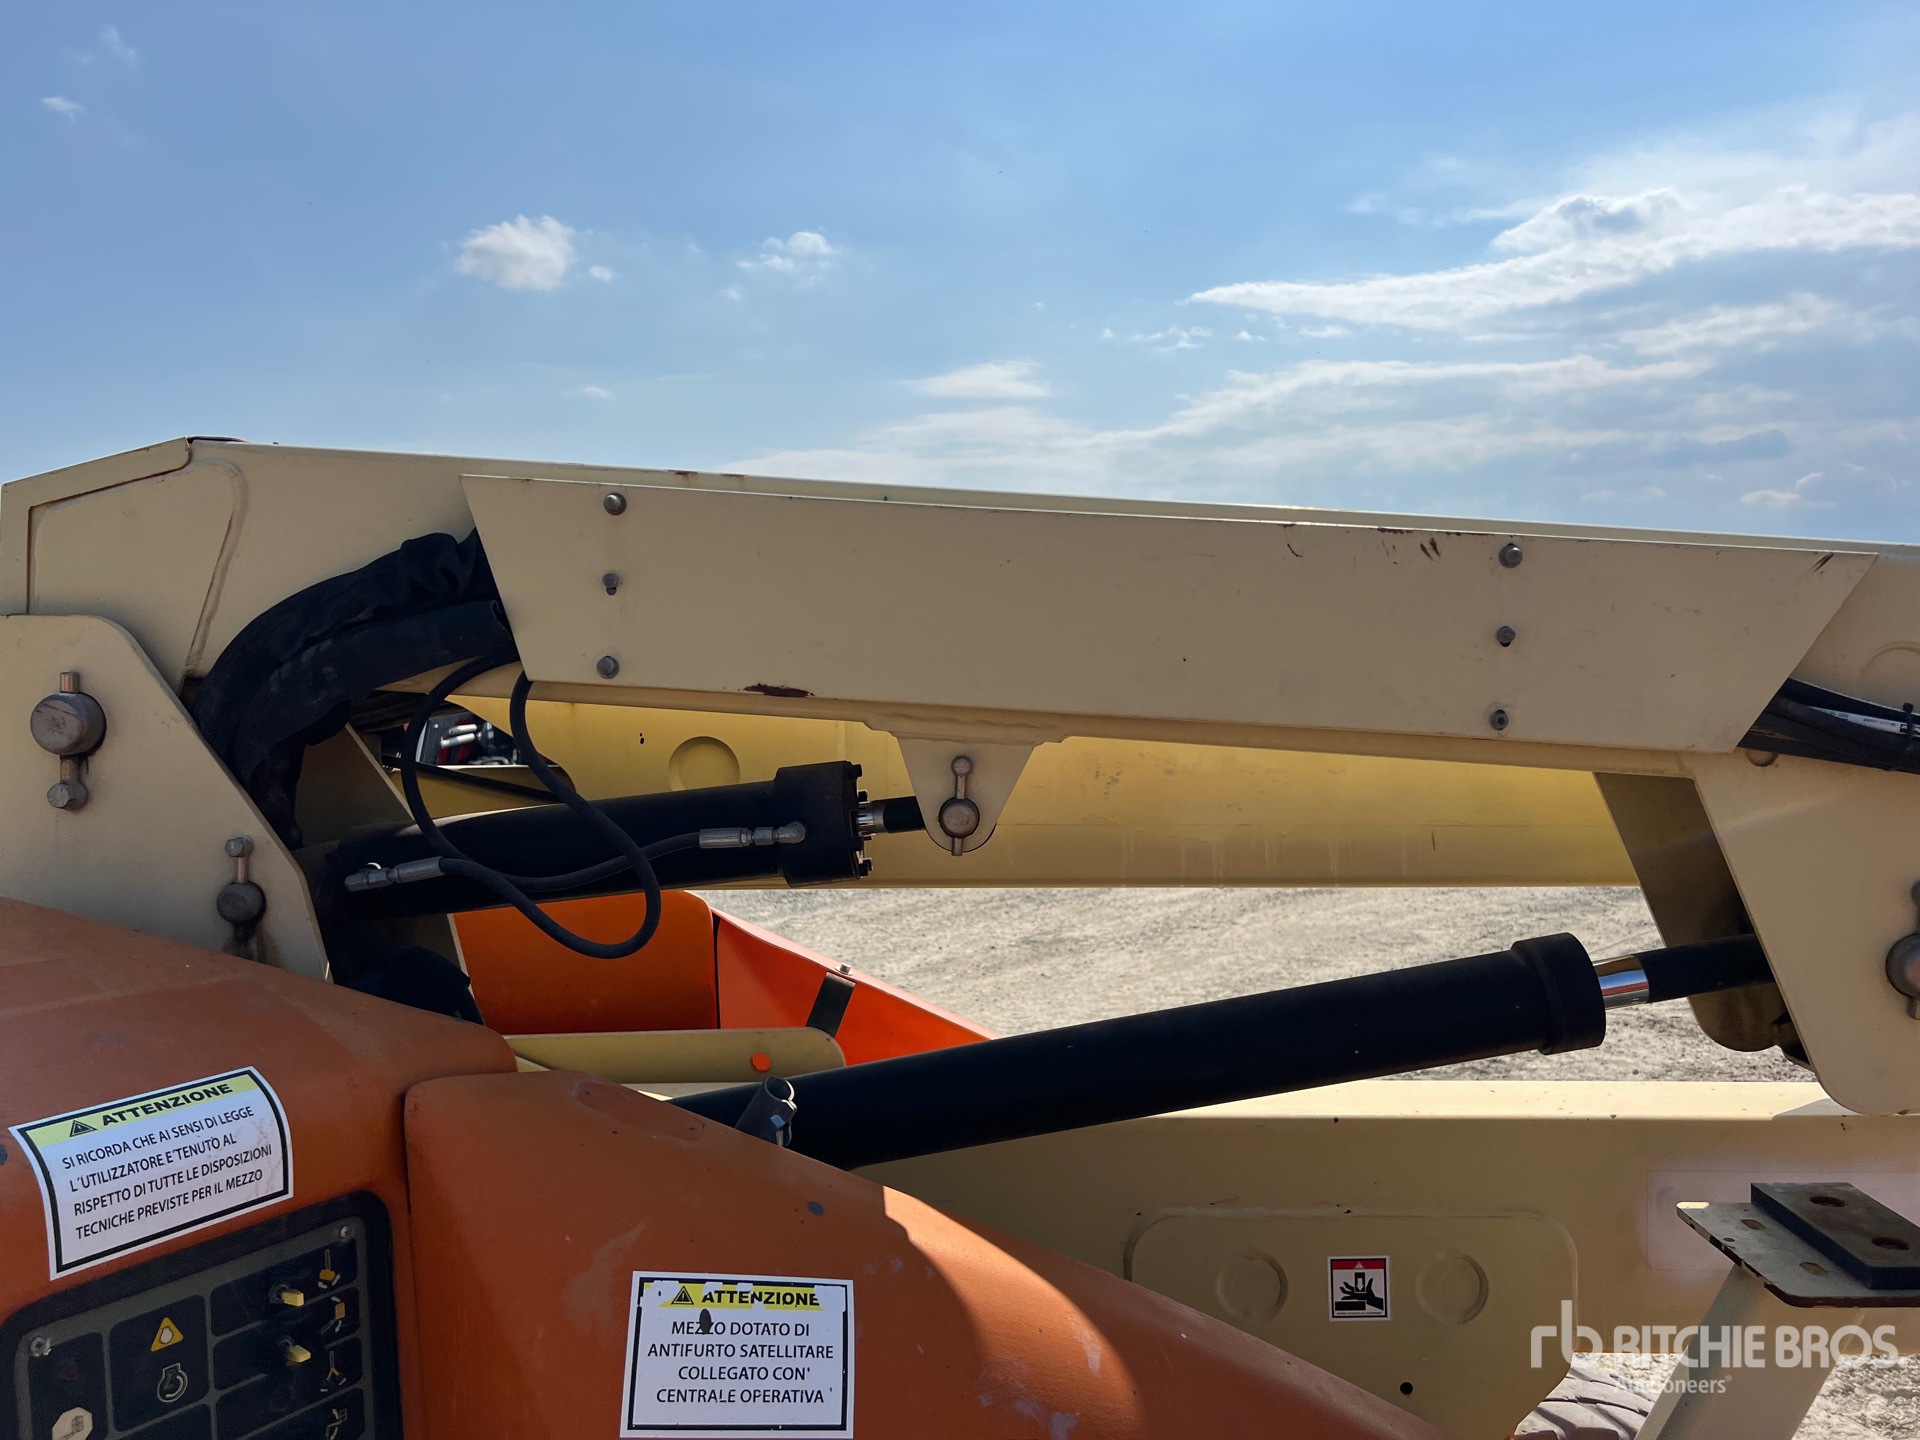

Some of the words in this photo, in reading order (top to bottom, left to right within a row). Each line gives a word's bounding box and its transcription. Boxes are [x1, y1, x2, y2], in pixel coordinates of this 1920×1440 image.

[102, 1083, 233, 1126] ATTENZIONE
[62, 1156, 76, 1170] SI
[77, 1141, 132, 1166] RICORDA
[132, 1133, 158, 1149] CHE
[159, 1129, 172, 1143] AI
[174, 1120, 205, 1138] SENSI
[205, 1115, 219, 1129] DI
[220, 1106, 255, 1125] LEGGE
[178, 1137, 221, 1160] TENUTO
[223, 1133, 238, 1147] AL
[74, 1188, 132, 1217] RISPETTO
[133, 1183, 147, 1198] DI
[148, 1171, 184, 1192] TUTTE
[186, 1168, 200, 1182] LE
[201, 1144, 273, 1177] DISPOSIZIONI
[76, 1210, 136, 1240] TECNICHE
[137, 1195, 190, 1220] PREVISTE
[191, 1186, 213, 1202] PER
[214, 1183, 224, 1195] IL
[225, 1169, 264, 1191] MEZZO
[701, 1290, 820, 1308] ATTENZIONE
[730, 1323, 791, 1337] DOTATO
[794, 1324, 810, 1337] DI
[648, 1343, 736, 1358] ANTIFURTO
[739, 1345, 834, 1359] SATELLITARE
[678, 1366, 769, 1381] COLLEGATO
[656, 1388, 736, 1404] CENTRALE
[740, 1389, 825, 1404] OPERATIVA
